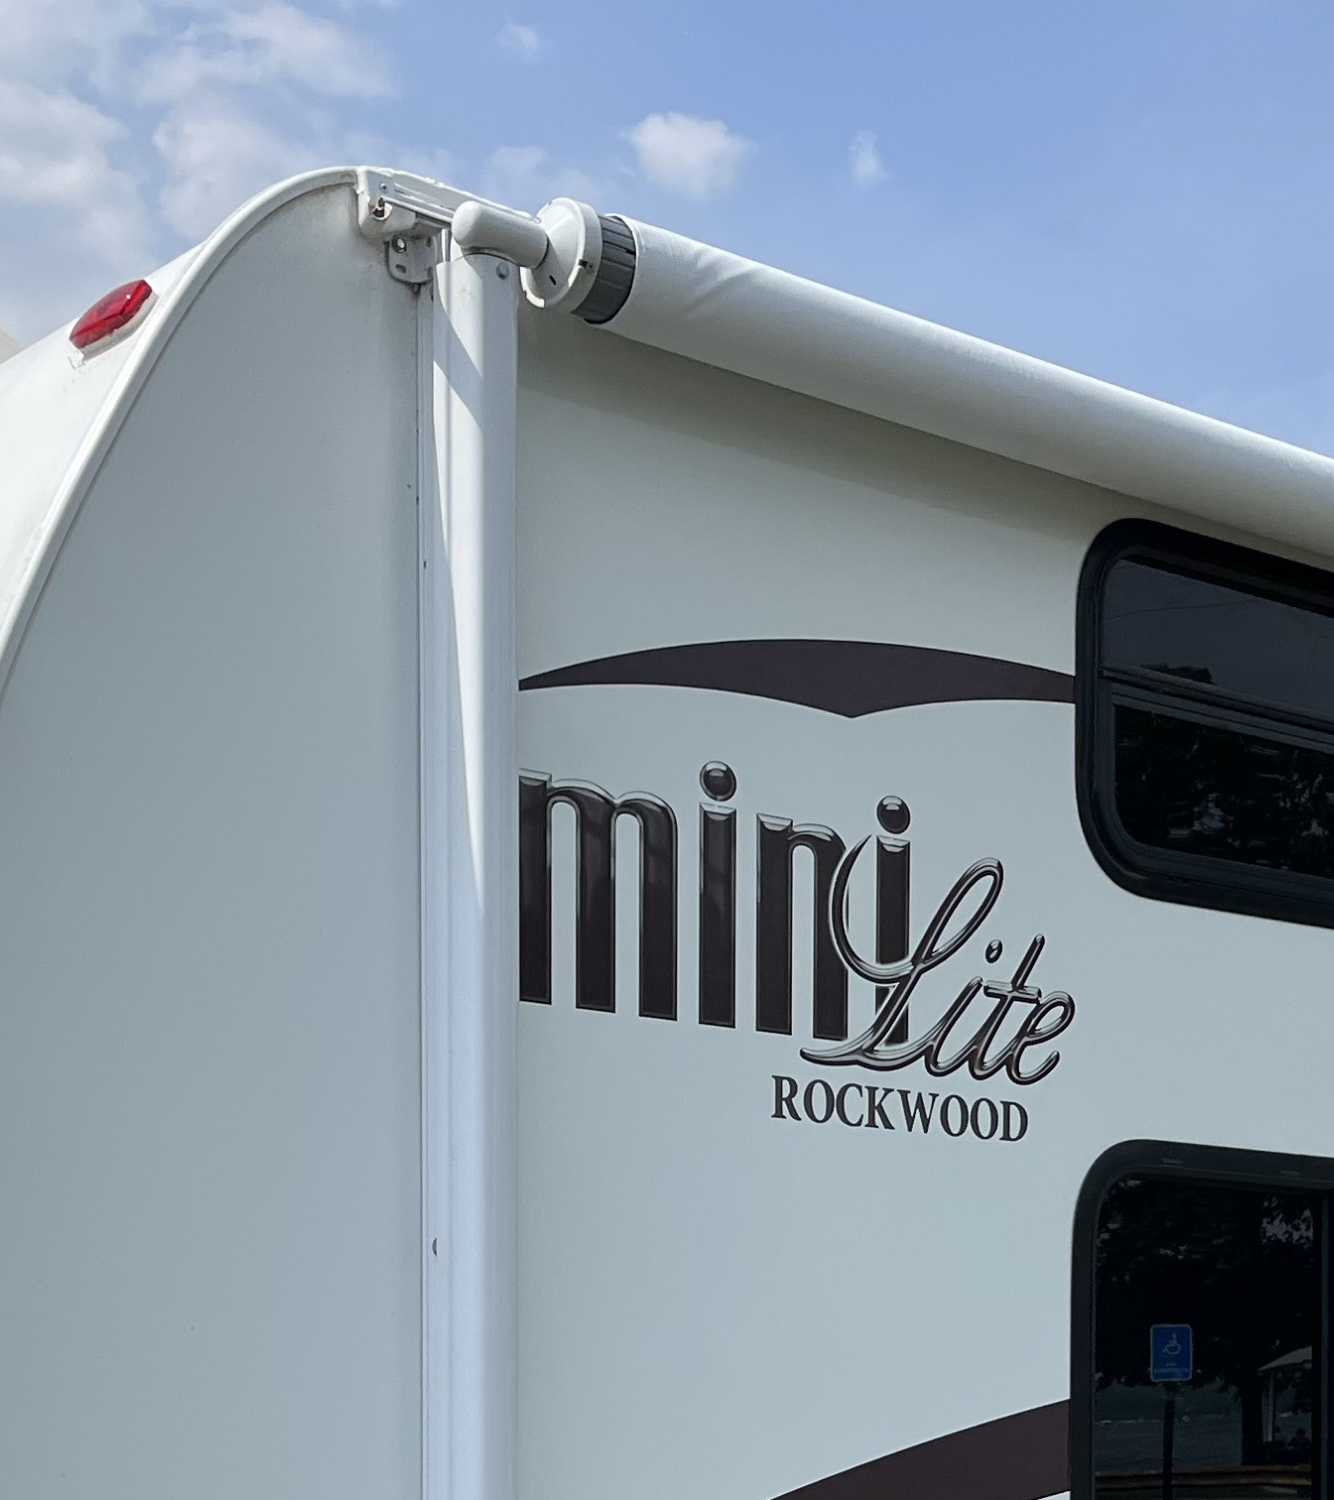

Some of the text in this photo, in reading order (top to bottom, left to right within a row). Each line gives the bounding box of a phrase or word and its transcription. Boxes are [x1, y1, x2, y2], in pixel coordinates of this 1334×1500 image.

[519, 760, 910, 1045] mini
[799, 857, 1075, 1085] Lite
[770, 1075, 1029, 1143] ROCKWOOD
